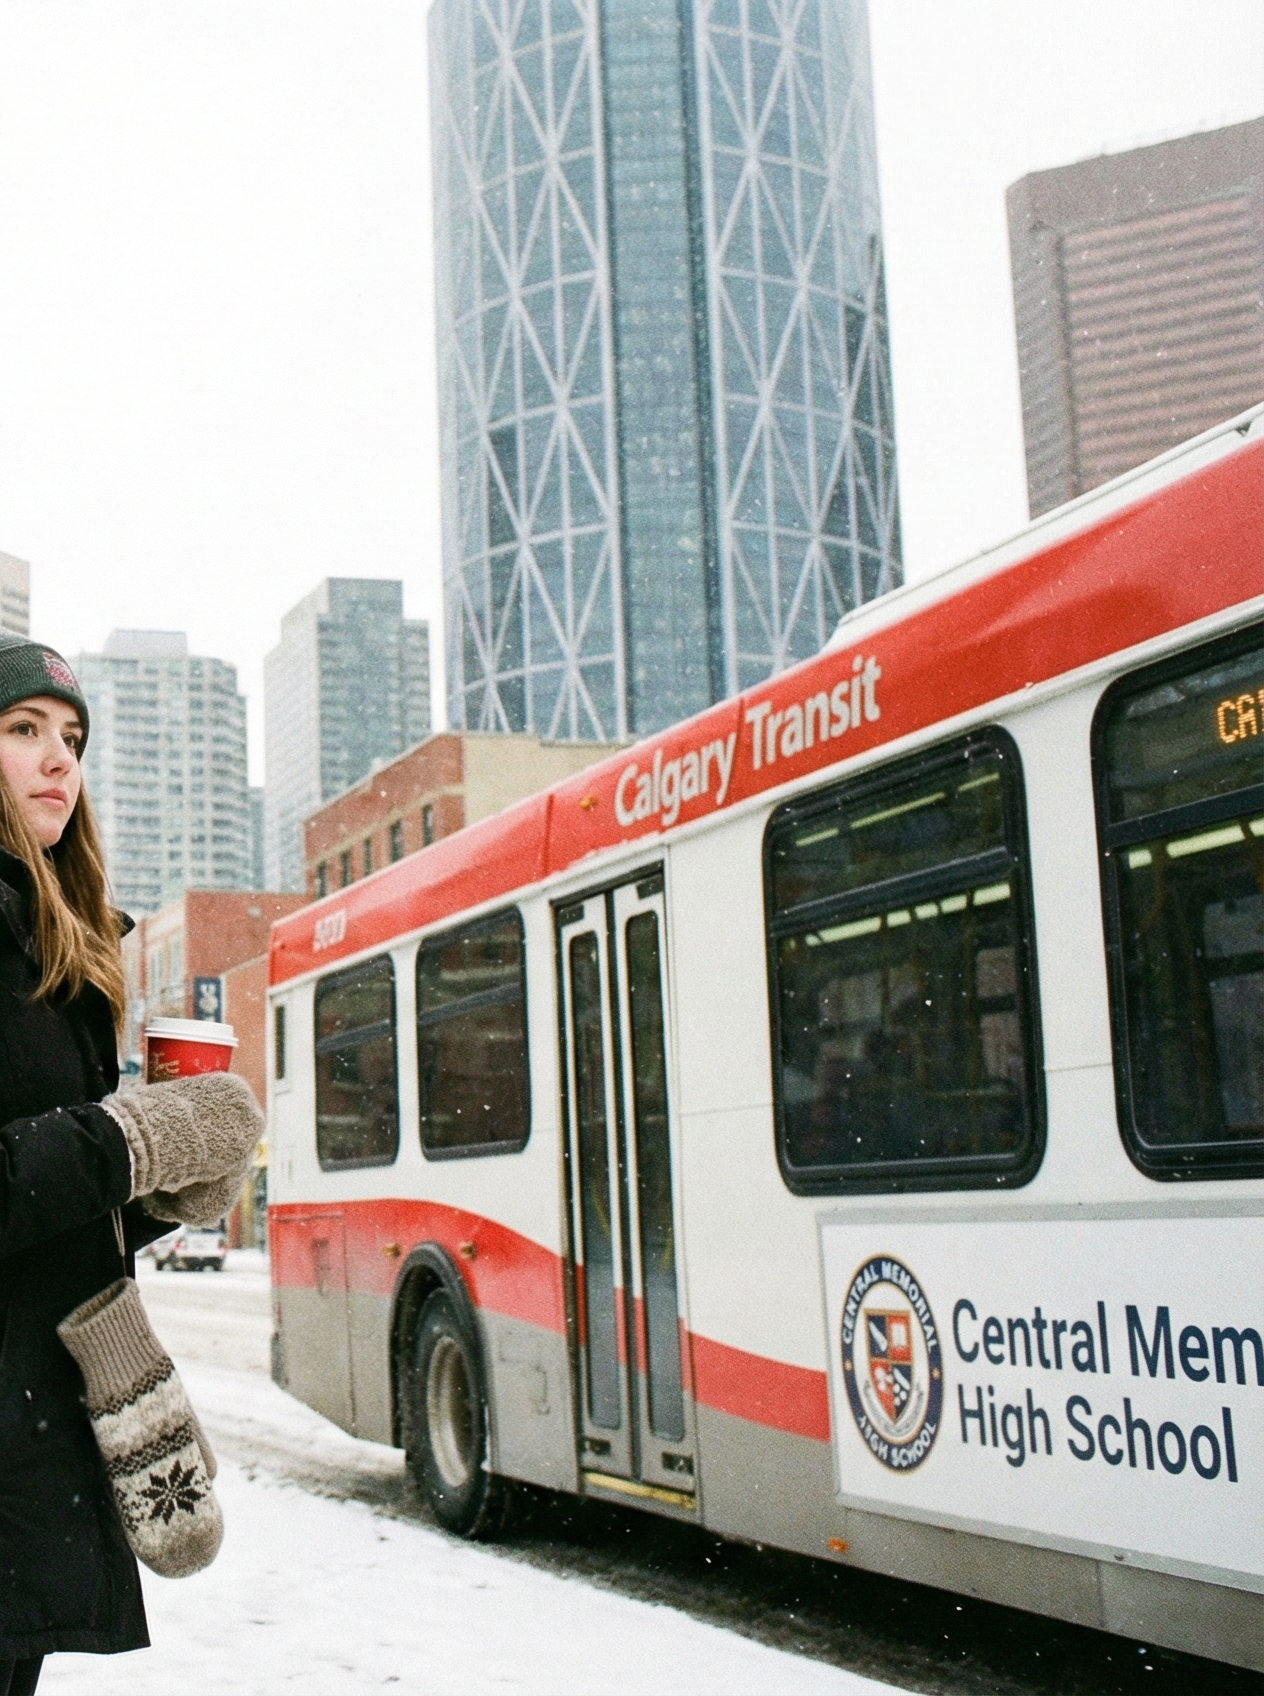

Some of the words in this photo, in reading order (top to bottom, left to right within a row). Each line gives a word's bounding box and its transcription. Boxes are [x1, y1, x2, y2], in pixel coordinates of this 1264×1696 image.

[615, 731, 736, 828] Calgary
[745, 655, 882, 771] Transit
[843, 1264, 879, 1344] CENTRAL
[881, 1261, 937, 1353] MEMORIAL
[952, 1299, 1110, 1374] Central
[1125, 1304, 1264, 1387] Mem
[958, 1383, 1053, 1468] High
[1066, 1394, 1239, 1483] School
